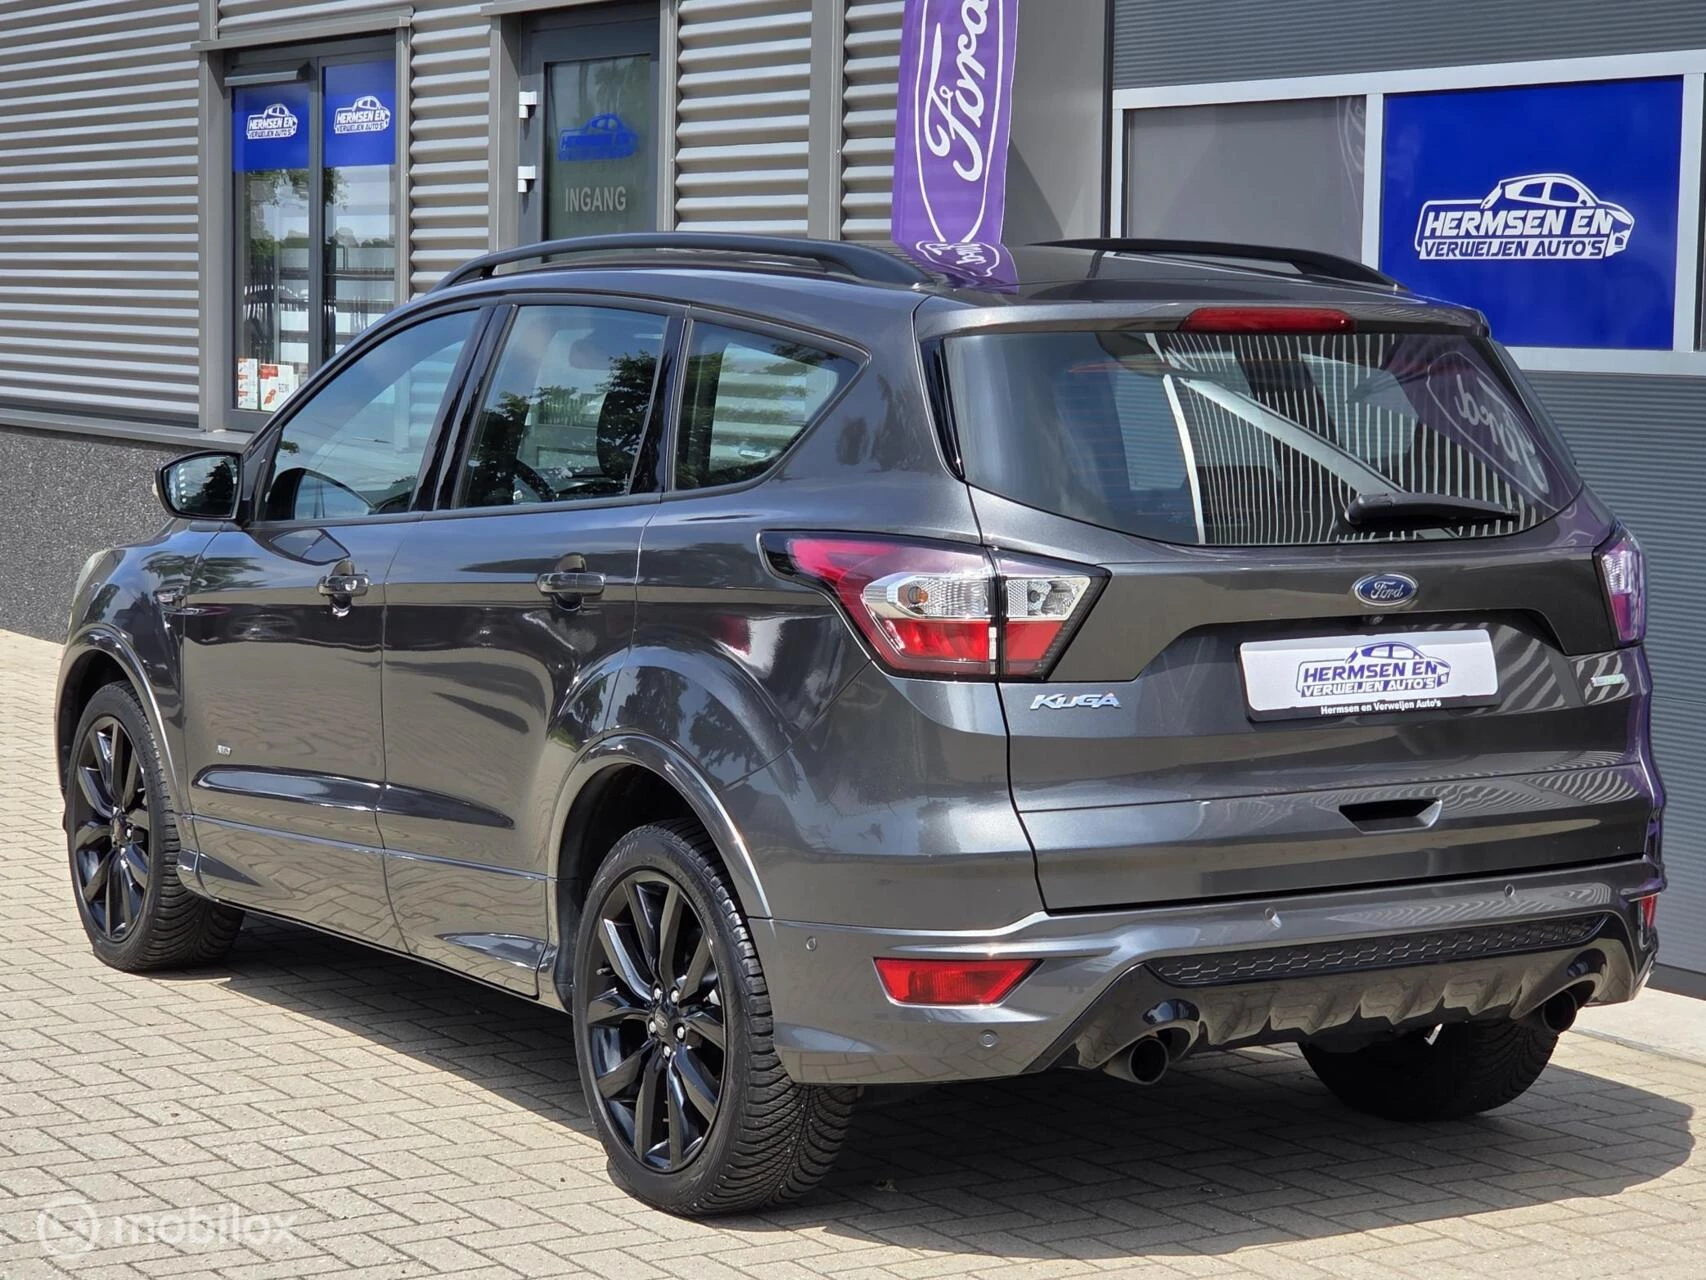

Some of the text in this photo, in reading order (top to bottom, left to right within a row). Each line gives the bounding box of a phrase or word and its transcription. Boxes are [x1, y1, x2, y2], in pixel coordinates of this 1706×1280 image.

[336, 110, 386, 123] HERMSEN EN
[565, 186, 626, 212] INGANG
[1424, 209, 1613, 237] HERMSEN EN
[1424, 240, 1604, 257] VERWEIJEN AUTO'S
[1371, 581, 1404, 599] Ford
[1303, 660, 1438, 682] HERMSEN EN
[1302, 676, 1436, 697] VERWEIJEN AUTO'S
[1030, 692, 1121, 710] KUGA
[1320, 698, 1442, 715] Hermsen en Verweijen Auto's
